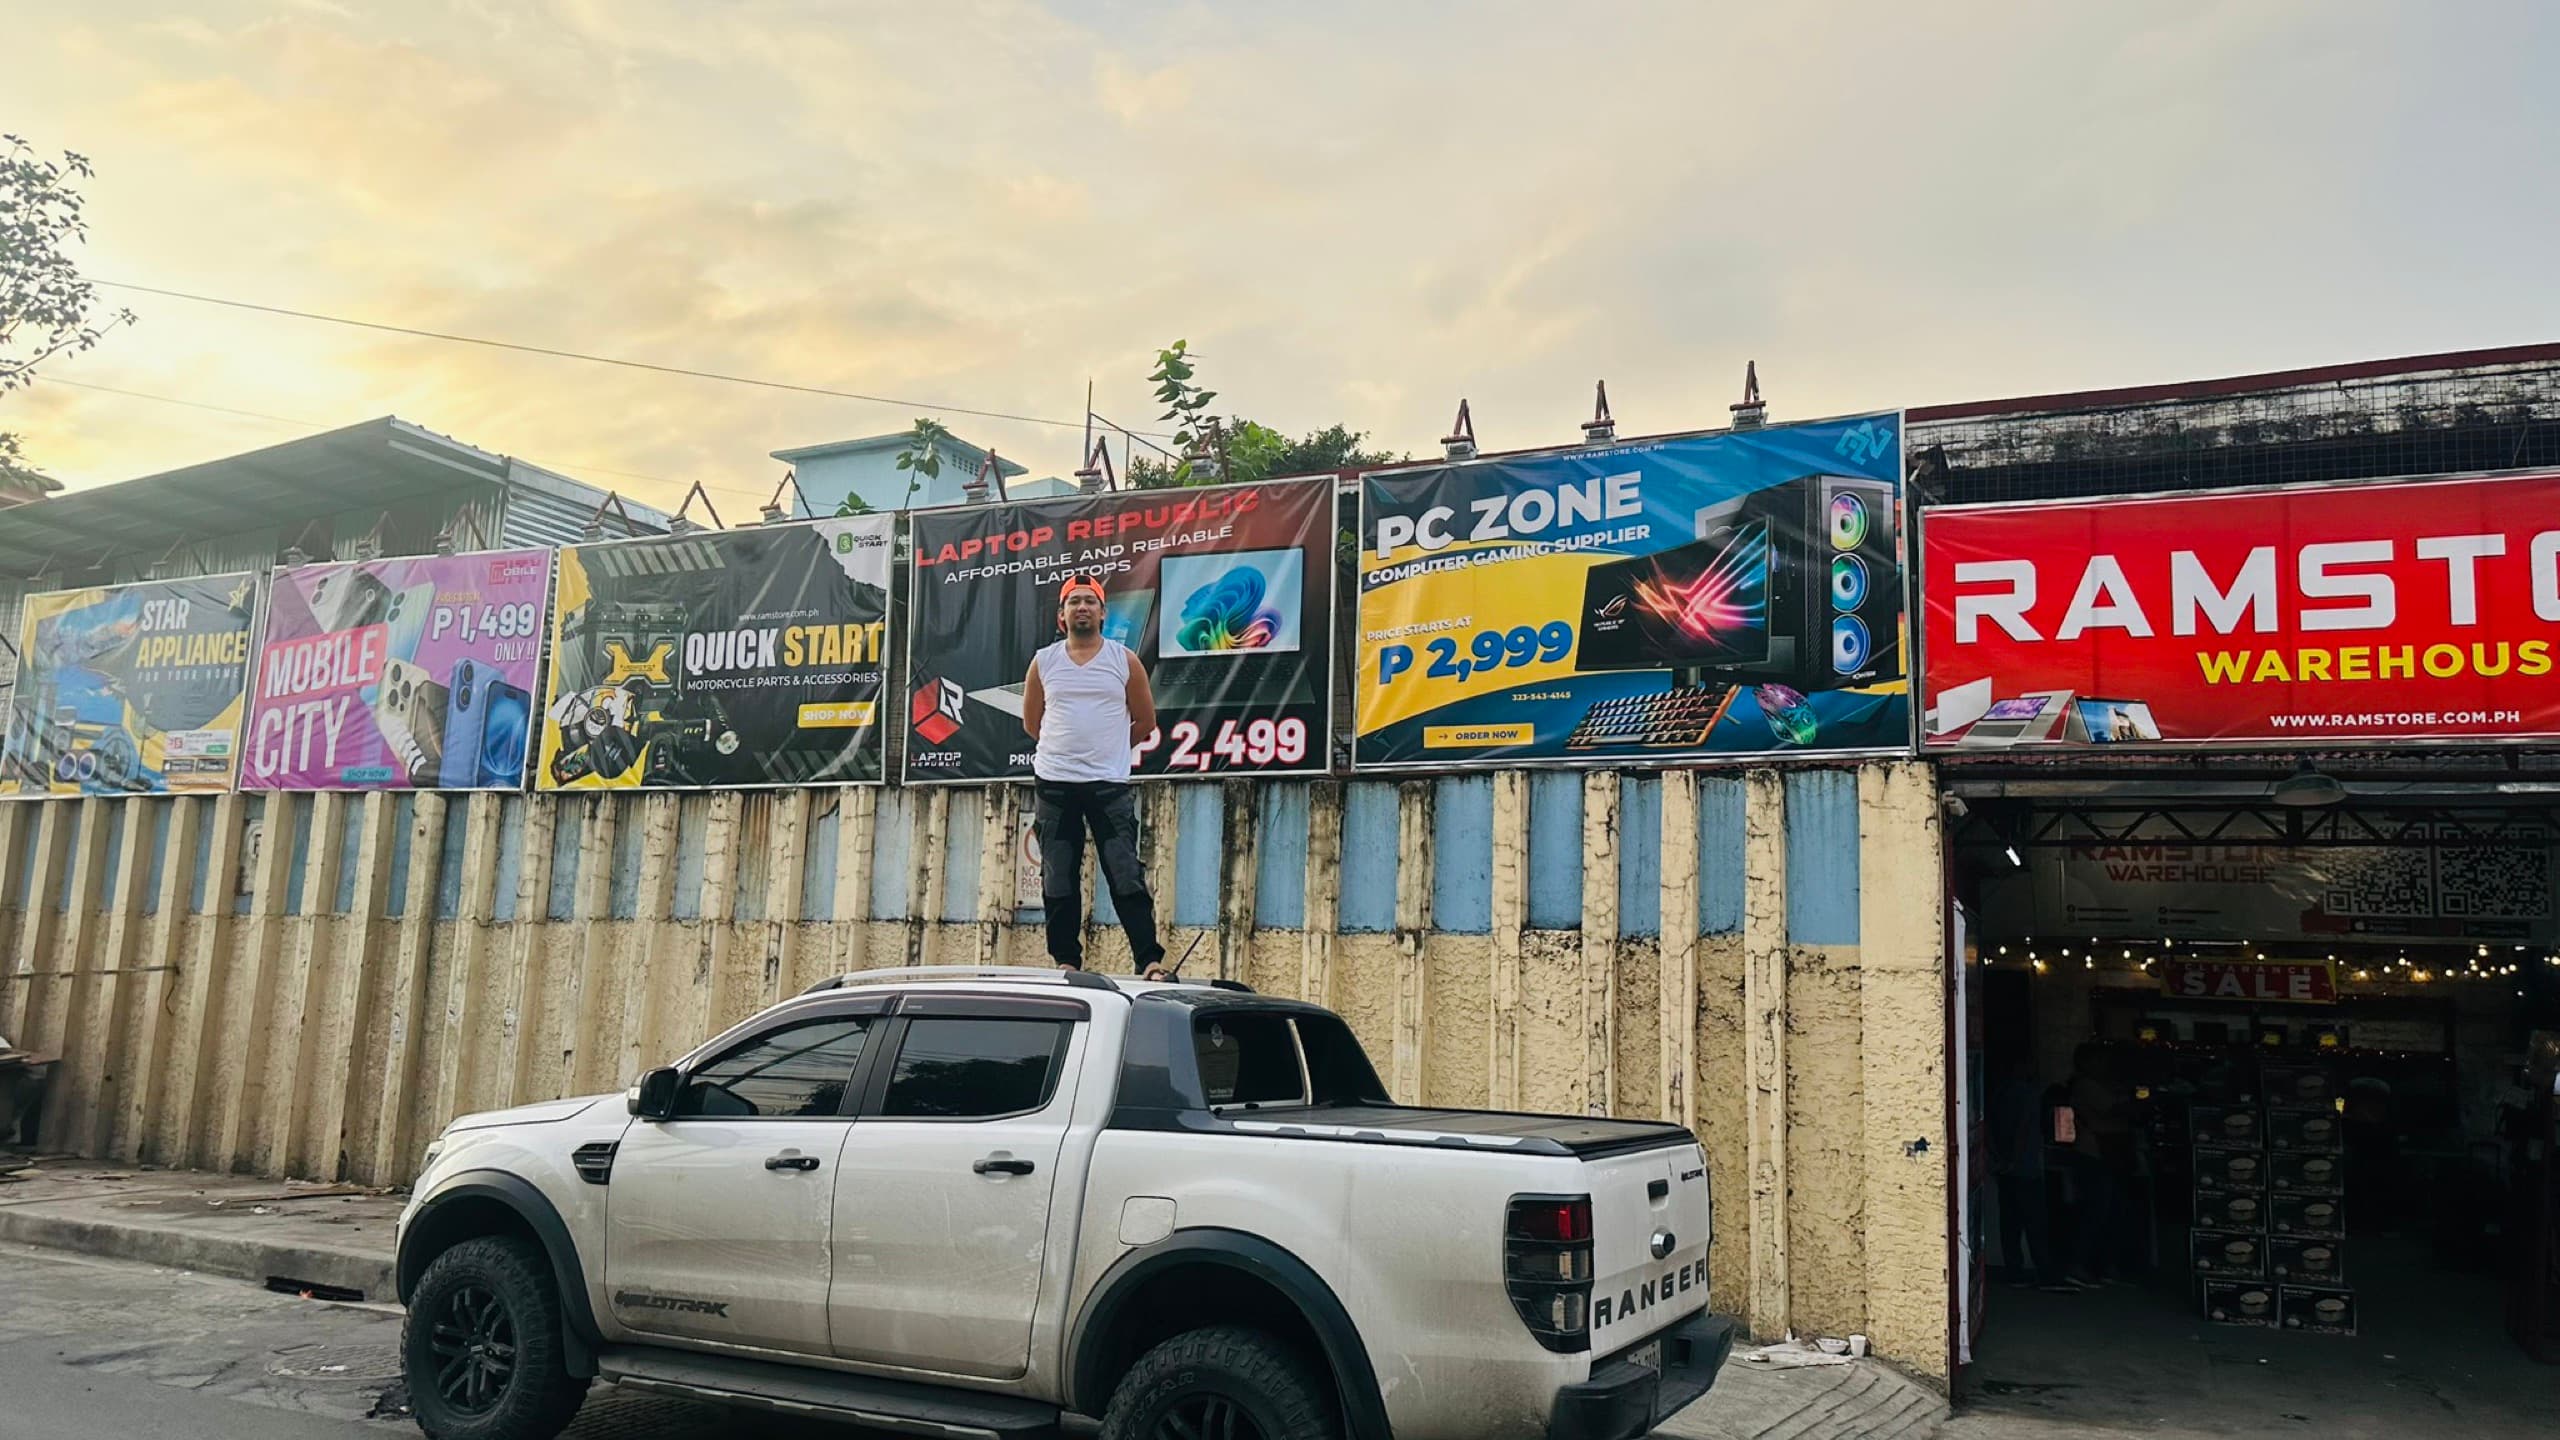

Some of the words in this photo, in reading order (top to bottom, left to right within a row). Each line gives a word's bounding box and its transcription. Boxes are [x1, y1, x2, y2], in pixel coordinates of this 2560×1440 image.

[915, 526, 1054, 567] LAPTOP
[1067, 490, 1260, 542] REPUBLIC
[1376, 506, 1454, 560] PC
[1470, 470, 1643, 543] ZONE
[944, 552, 1072, 585] AFFORDABLE
[1079, 544, 1125, 562] AND
[1132, 525, 1234, 554] RELIABLE
[1035, 558, 1132, 587] LAPTOPS
[1368, 554, 1473, 585] COMPUTER
[1473, 543, 1551, 567] GAMING
[1553, 524, 1650, 552] SUPPLIER
[141, 599, 191, 632] STAR
[431, 605, 454, 641] P
[459, 602, 537, 644] 1,499
[1366, 627, 1402, 641] PRICE
[1404, 618, 1452, 636] STARTS
[1454, 615, 1473, 629] AT
[135, 631, 249, 669] APPLIANCE
[264, 629, 380, 699] MOBILE
[495, 641, 526, 662] ONLY
[685, 628, 780, 676] QUICK
[784, 622, 885, 667] START
[1379, 645, 1414, 684] P
[1426, 620, 1574, 683] 2,999
[2197, 641, 2553, 684] WAREHOUS
[686, 677, 755, 691] MOTORCYCLE
[757, 675, 790, 688] PARTS
[792, 675, 800, 686] &
[802, 671, 879, 686] ACCESSORIES
[803, 710, 836, 721] SHOP
[838, 709, 869, 721] NOW
[2271, 710, 2521, 728] WWW.RAMSTORE.COM.PH
[254, 695, 351, 779] CITY
[1170, 717, 1307, 772] 2,499
[1455, 731, 1490, 741] ORDER
[1492, 730, 1519, 740] NOW
[911, 752, 962, 762] LAPTOP
[1022, 865, 1036, 877] NO
[2105, 865, 2276, 883] WAREHOUSE
[2183, 973, 2312, 999] SALE
[1594, 1258, 1705, 1330] RANGER
